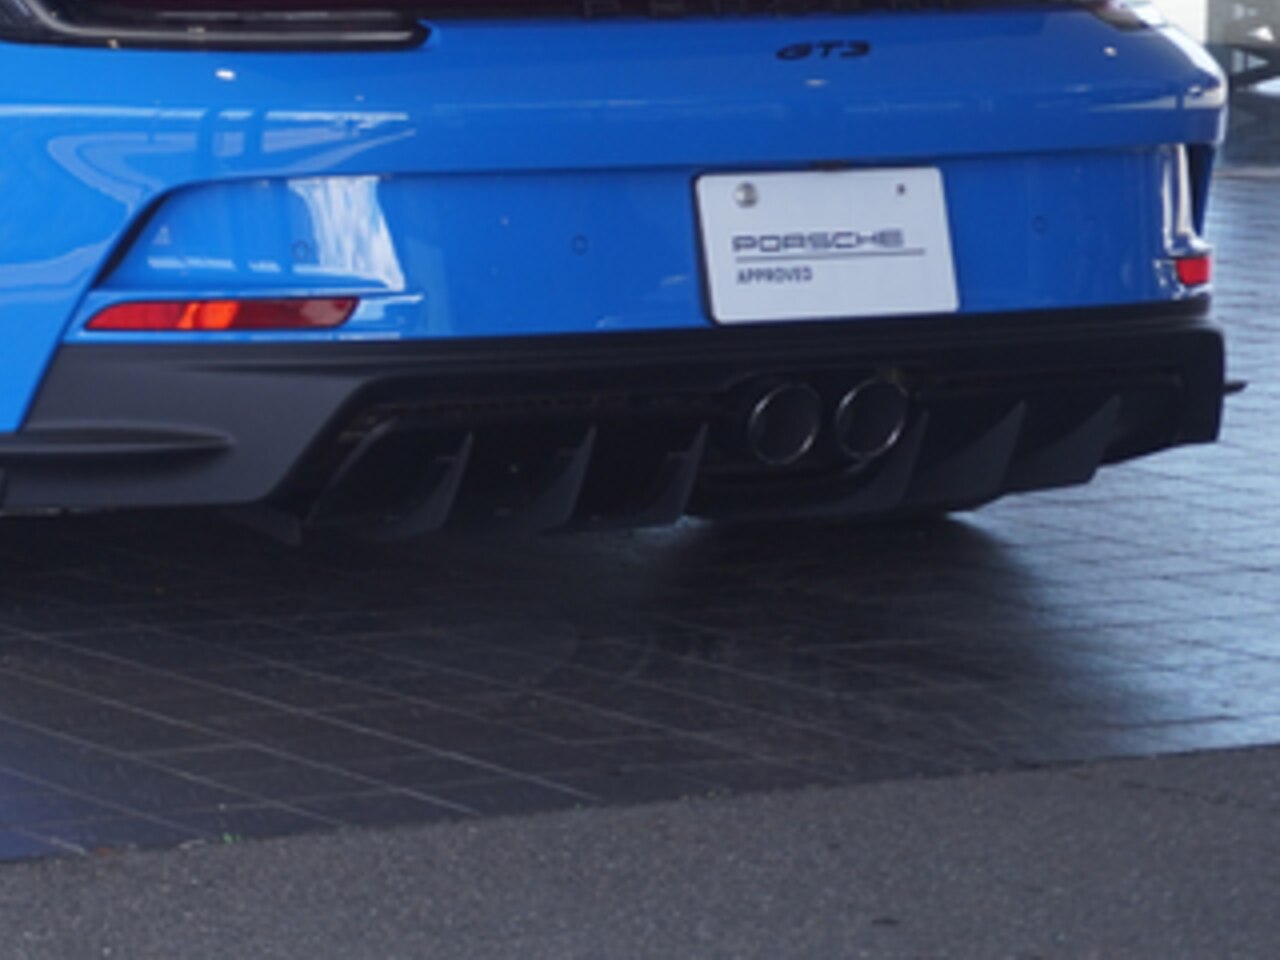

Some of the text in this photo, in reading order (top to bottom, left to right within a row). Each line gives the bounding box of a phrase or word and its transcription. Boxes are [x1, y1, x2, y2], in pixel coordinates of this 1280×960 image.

[776, 39, 871, 61] GT3
[732, 228, 905, 253] PORSCHE
[736, 266, 813, 284] APPROVED
